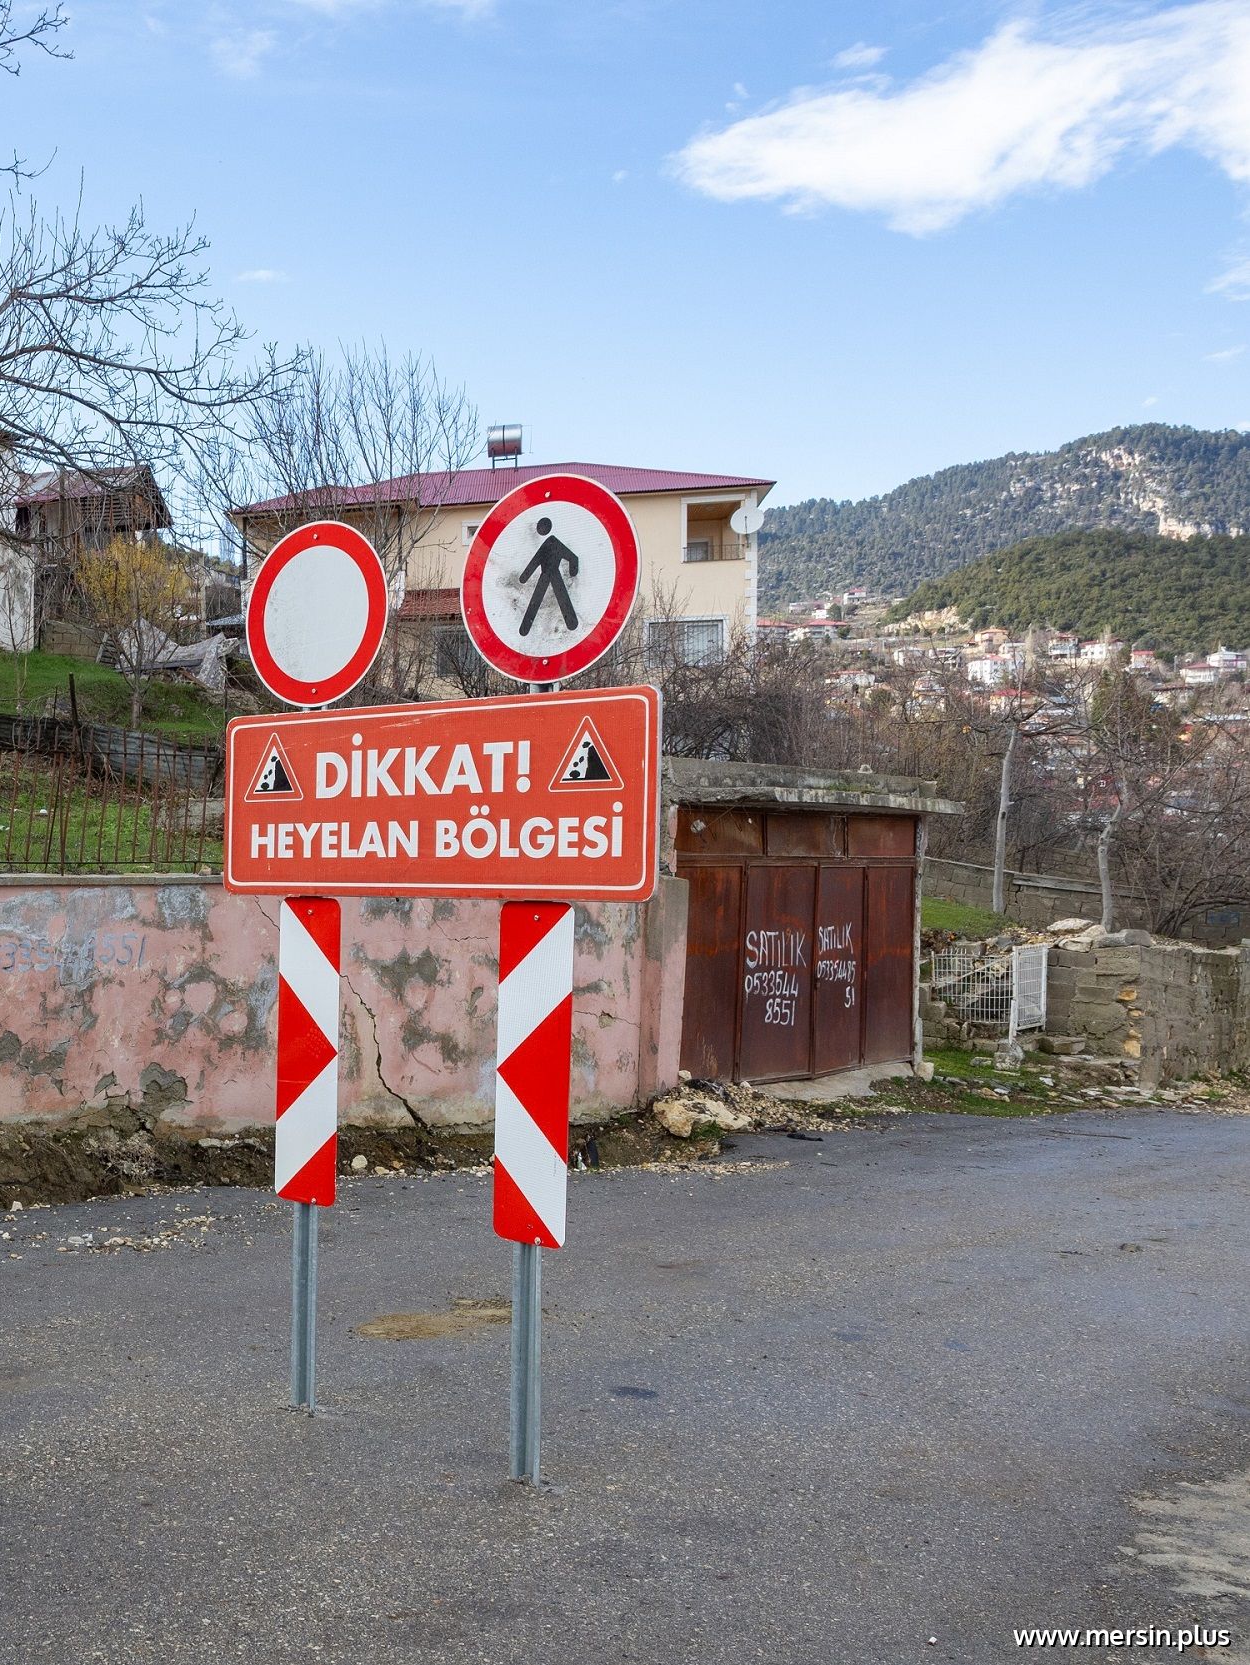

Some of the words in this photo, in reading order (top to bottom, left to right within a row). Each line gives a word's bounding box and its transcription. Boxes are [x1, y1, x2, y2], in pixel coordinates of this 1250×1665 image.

[316, 733, 531, 799] DİKKAT!
[251, 820, 419, 860] HEYELAN
[435, 802, 624, 858] BÖLGESİ
[745, 970, 798, 999] 0533544
[844, 985, 855, 1008] 51
[765, 998, 796, 1026] 8551
